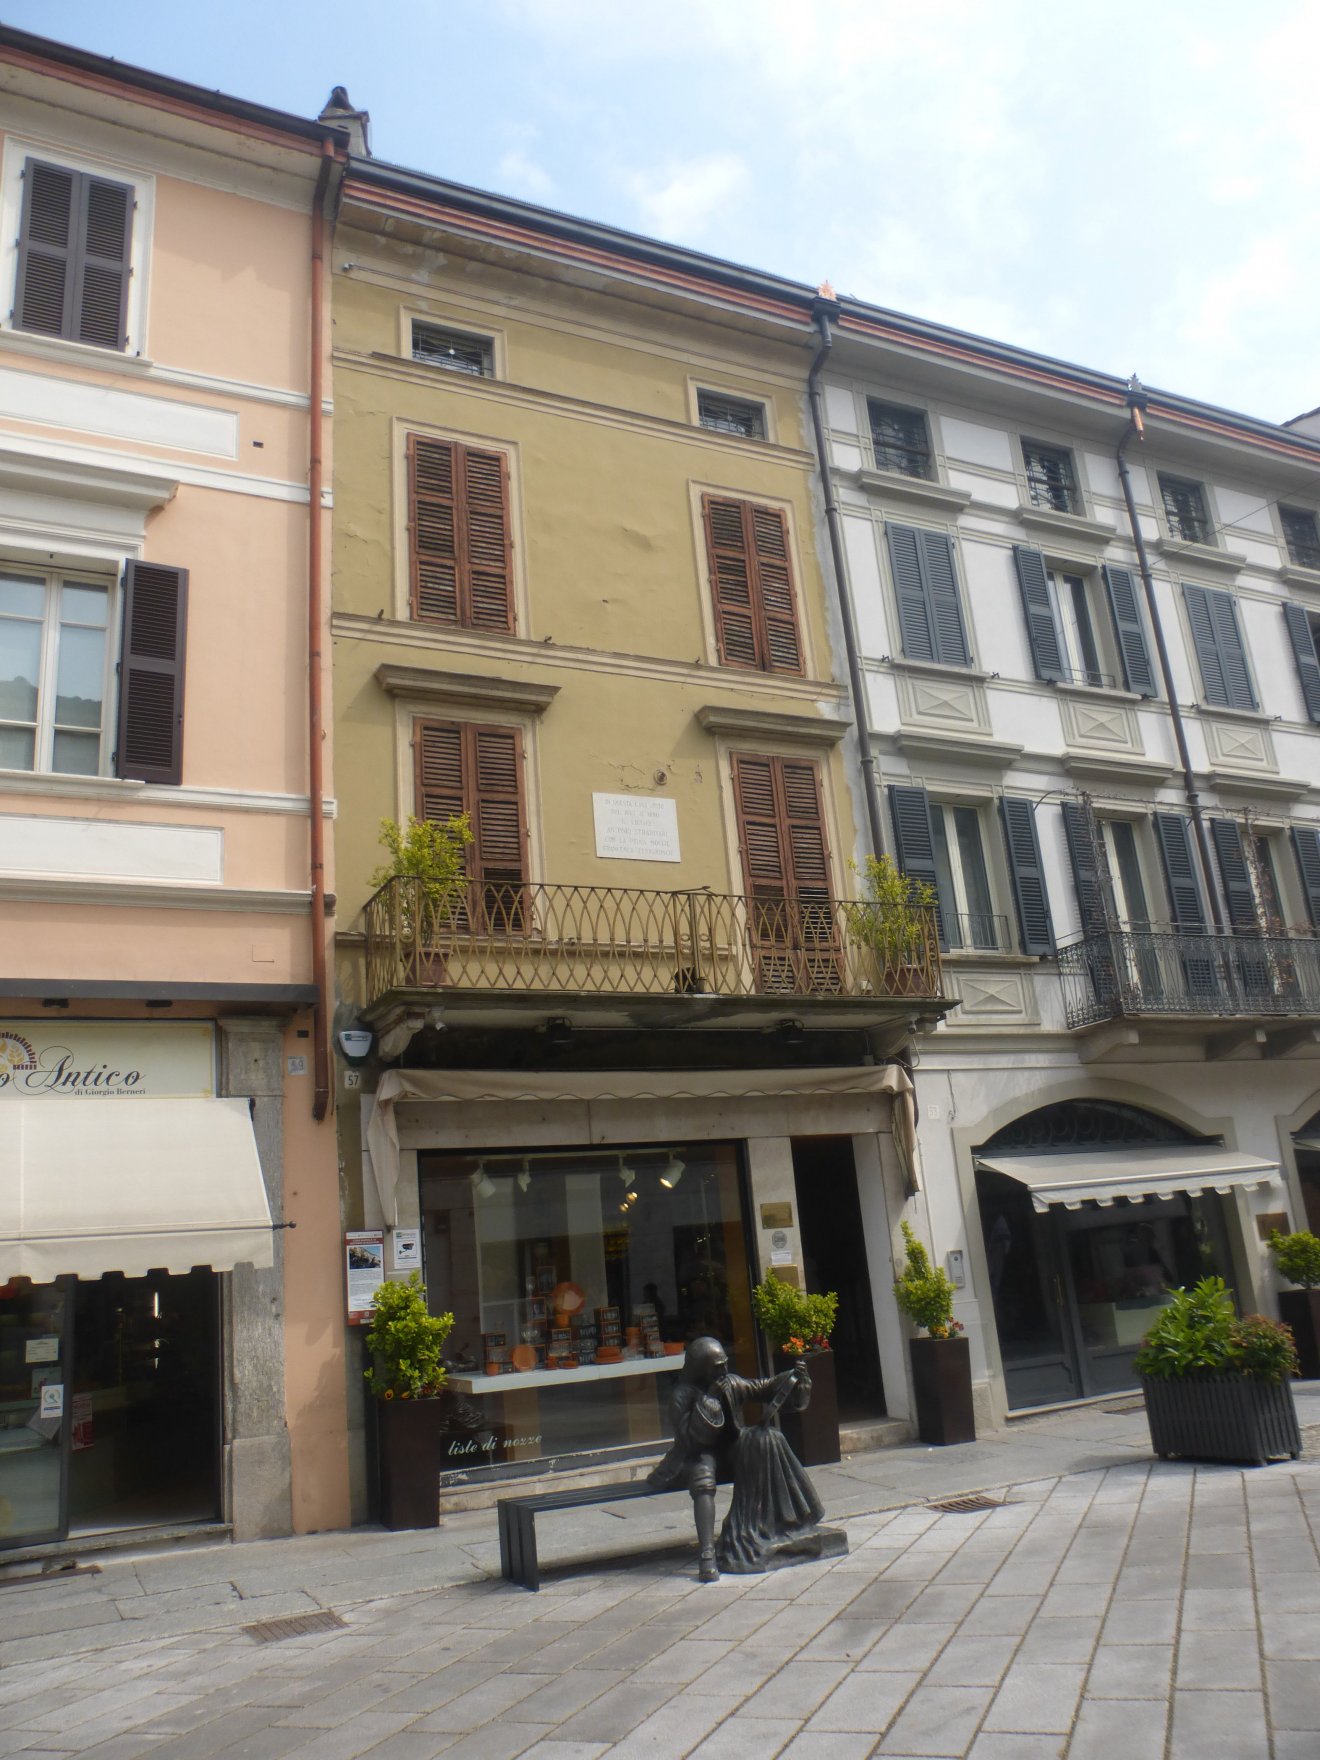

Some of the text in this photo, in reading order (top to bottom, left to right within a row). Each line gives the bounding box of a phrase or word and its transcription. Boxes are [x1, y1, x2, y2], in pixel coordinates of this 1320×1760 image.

[14, 1045, 146, 1095] Antico
[347, 1074, 359, 1087] 57
[74, 1087, 146, 1097] di Giorgio Berneri
[448, 1435, 543, 1456] liste di nozze
